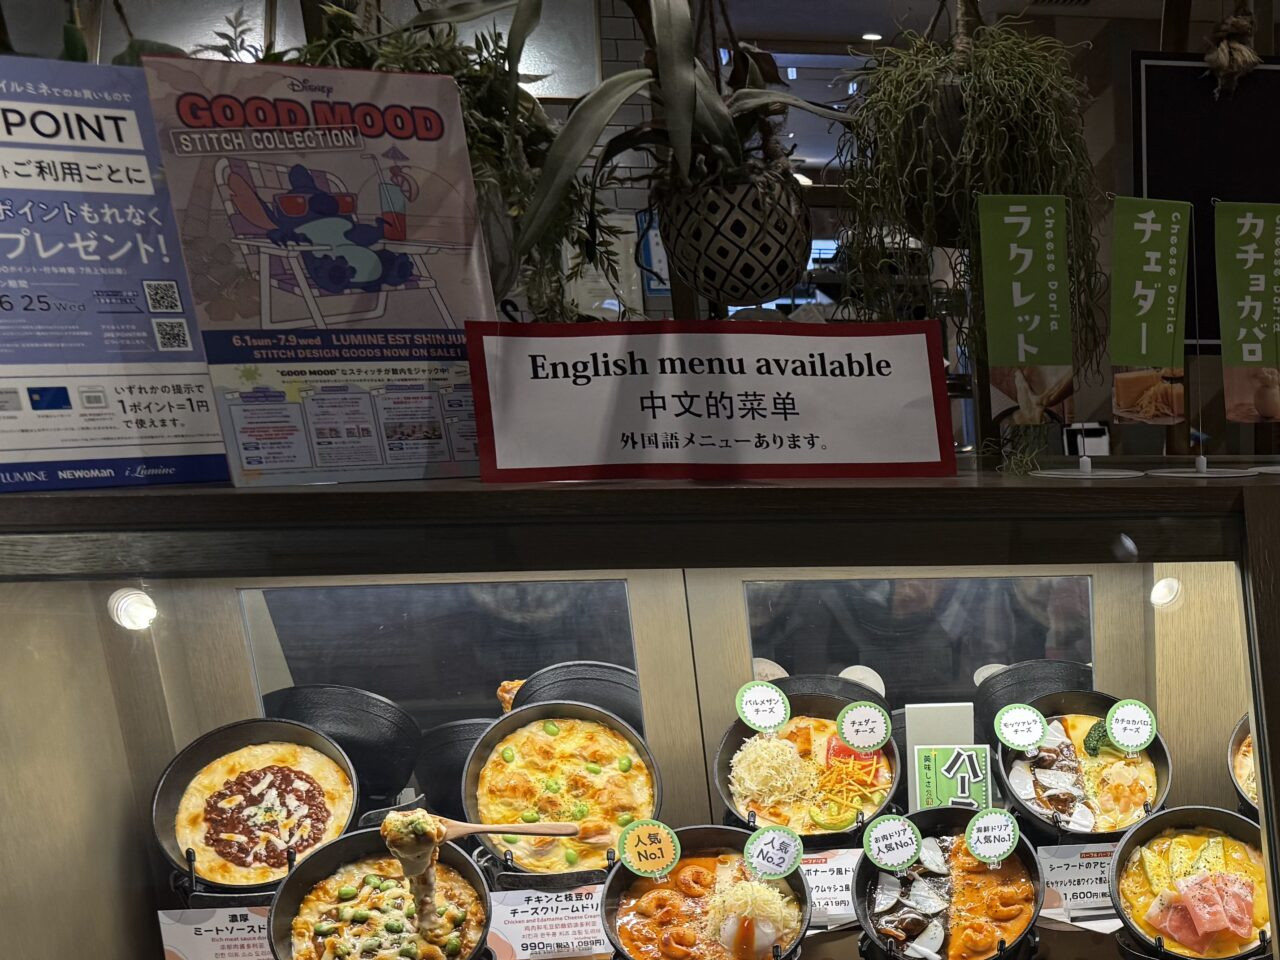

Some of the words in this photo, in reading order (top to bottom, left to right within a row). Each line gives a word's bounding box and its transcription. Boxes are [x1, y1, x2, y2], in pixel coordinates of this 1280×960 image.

[1, 108, 127, 143] POINT
[176, 92, 309, 132] GOOD
[312, 101, 444, 141] MOOD
[180, 132, 246, 152] STITCH
[252, 128, 356, 150] COLLECTION
[0, 199, 162, 226] ポイントもれなく
[0, 228, 170, 264] プレゼント!
[1044, 206, 1056, 273] Cheese
[1168, 212, 1181, 277] Cheese
[1004, 205, 1041, 362] ラクレット
[1133, 209, 1162, 355] チェダー
[1235, 212, 1267, 362] カチョカバロ
[21, 294, 51, 312] 25
[54, 302, 86, 312] Wed
[1048, 281, 1059, 332] Doria
[1166, 285, 1177, 334] Doria
[332, 334, 387, 346] LUMINE
[388, 334, 411, 345] EST
[254, 350, 295, 359] STITCH
[298, 350, 340, 359] DESIGN
[342, 349, 381, 358] GOODS
[383, 349, 409, 358] NOW
[412, 349, 428, 357] ON
[528, 351, 648, 386] English
[659, 353, 746, 376] menu
[756, 350, 892, 378] available
[114, 384, 205, 395] いずれかの提示で
[118, 398, 210, 415] 1ポイント=1円
[640, 390, 800, 422] 中文的菜单
[124, 418, 186, 429] で使えます。
[620, 431, 830, 451] 外国語メニューあります。
[57, 468, 115, 480] NEWoMan
[850, 719, 877, 727] チェダー
[874, 828, 907, 844] お肉ドリア
[976, 824, 1009, 834] 海鮮ドリア
[634, 832, 662, 848] 人気
[764, 836, 791, 854] 人気
[637, 847, 665, 862] No.1
[756, 848, 785, 868] No.2
[524, 892, 594, 905] チキンと枝豆の
[228, 913, 249, 923] 濃厚
[193, 925, 267, 936] ミートソースド
[521, 939, 605, 951] 990円(税込1,089円)
